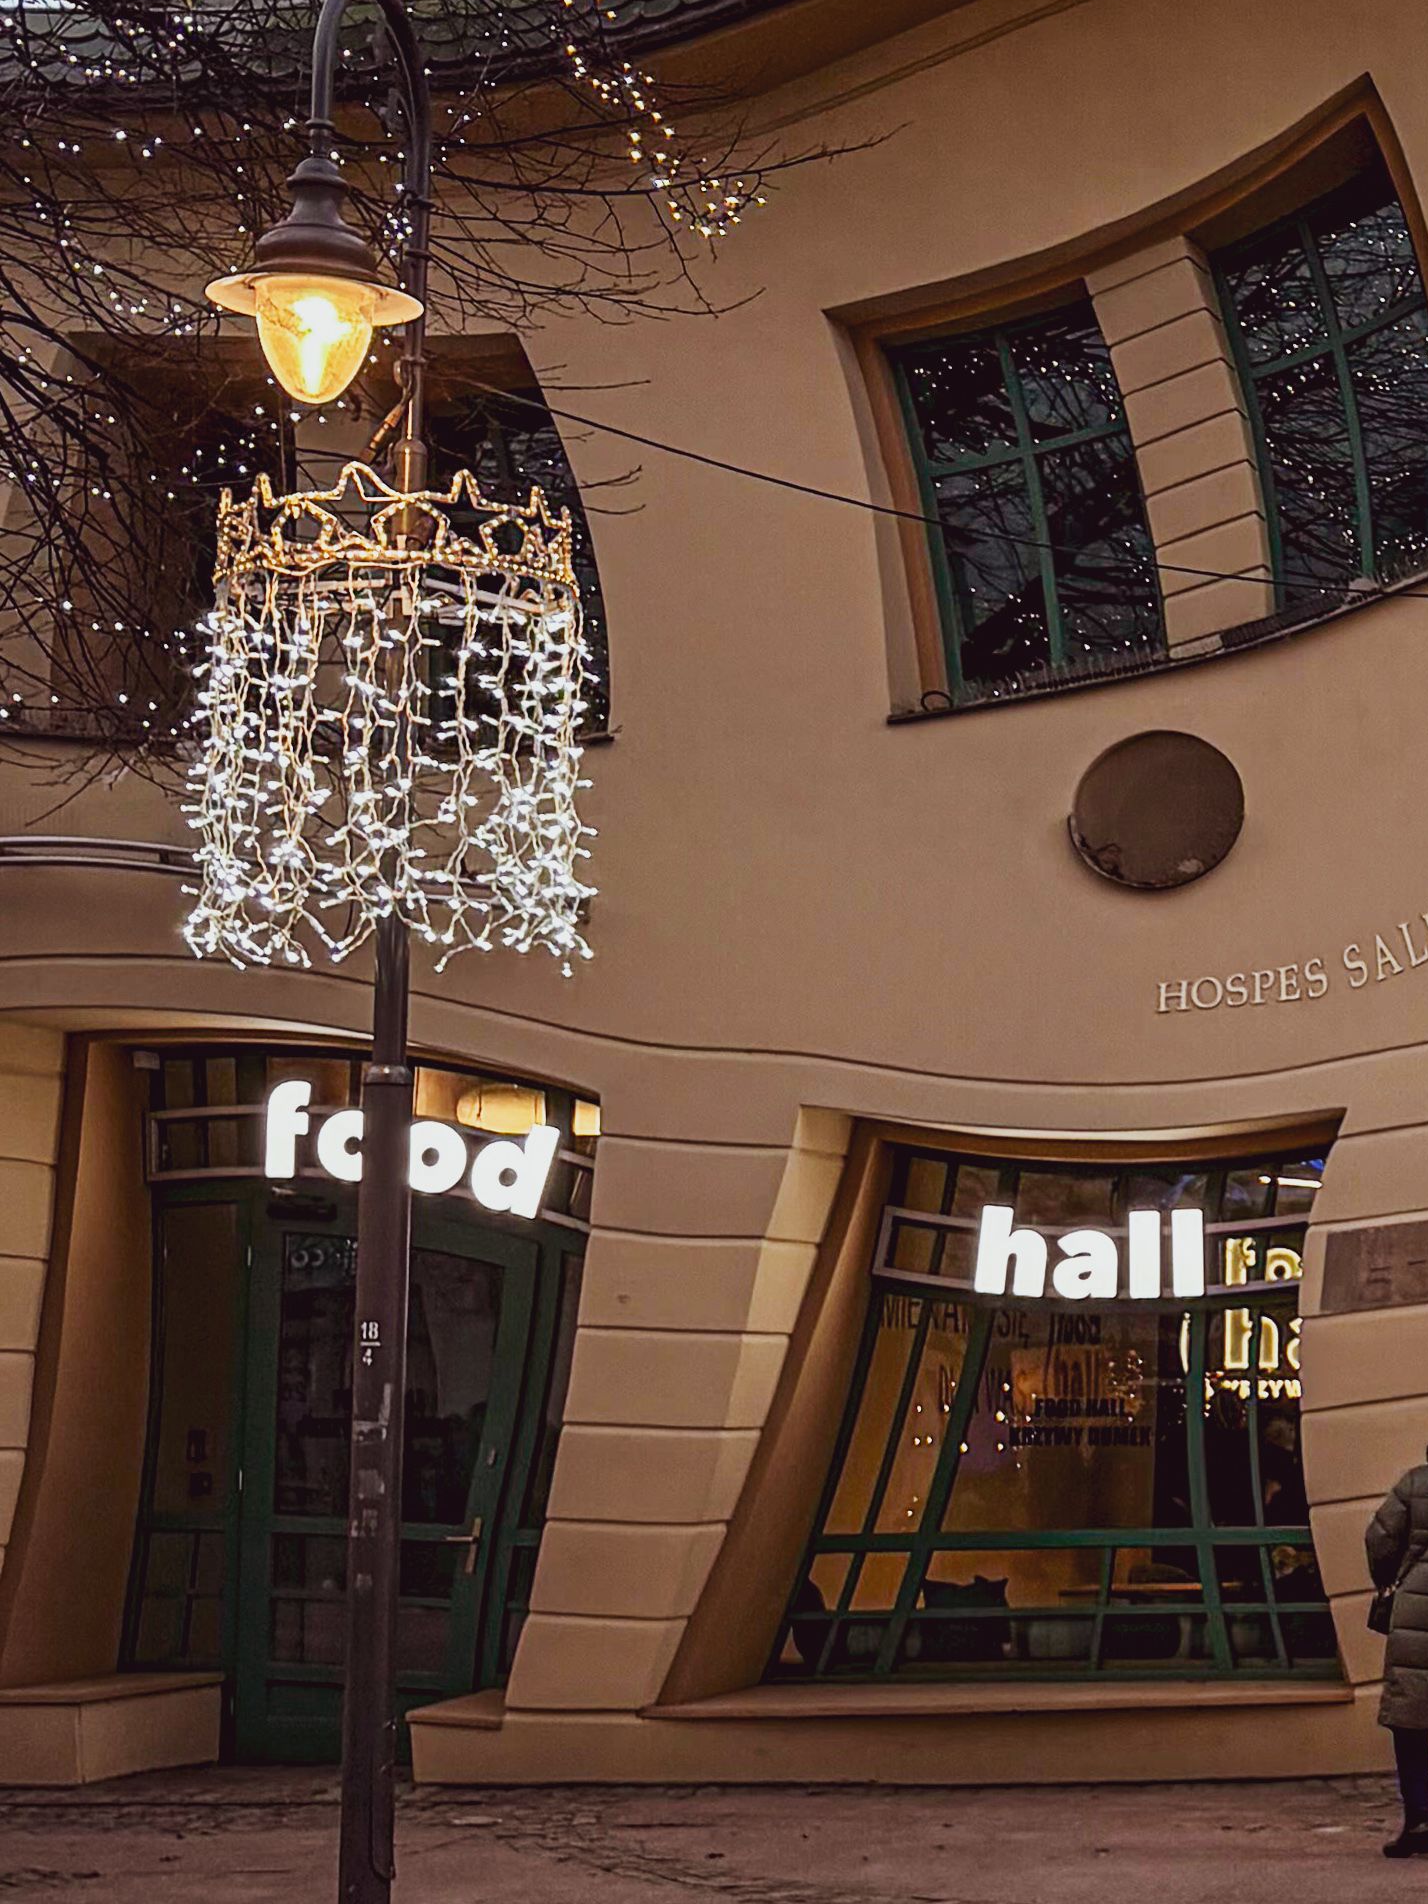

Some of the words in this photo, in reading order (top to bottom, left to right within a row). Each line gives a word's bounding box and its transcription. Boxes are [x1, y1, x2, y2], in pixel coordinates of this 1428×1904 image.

[1157, 958, 1330, 1013] HOSPES
[974, 1204, 1206, 1300] hall
[360, 1321, 380, 1341] 18
[362, 1348, 373, 1366] 4
